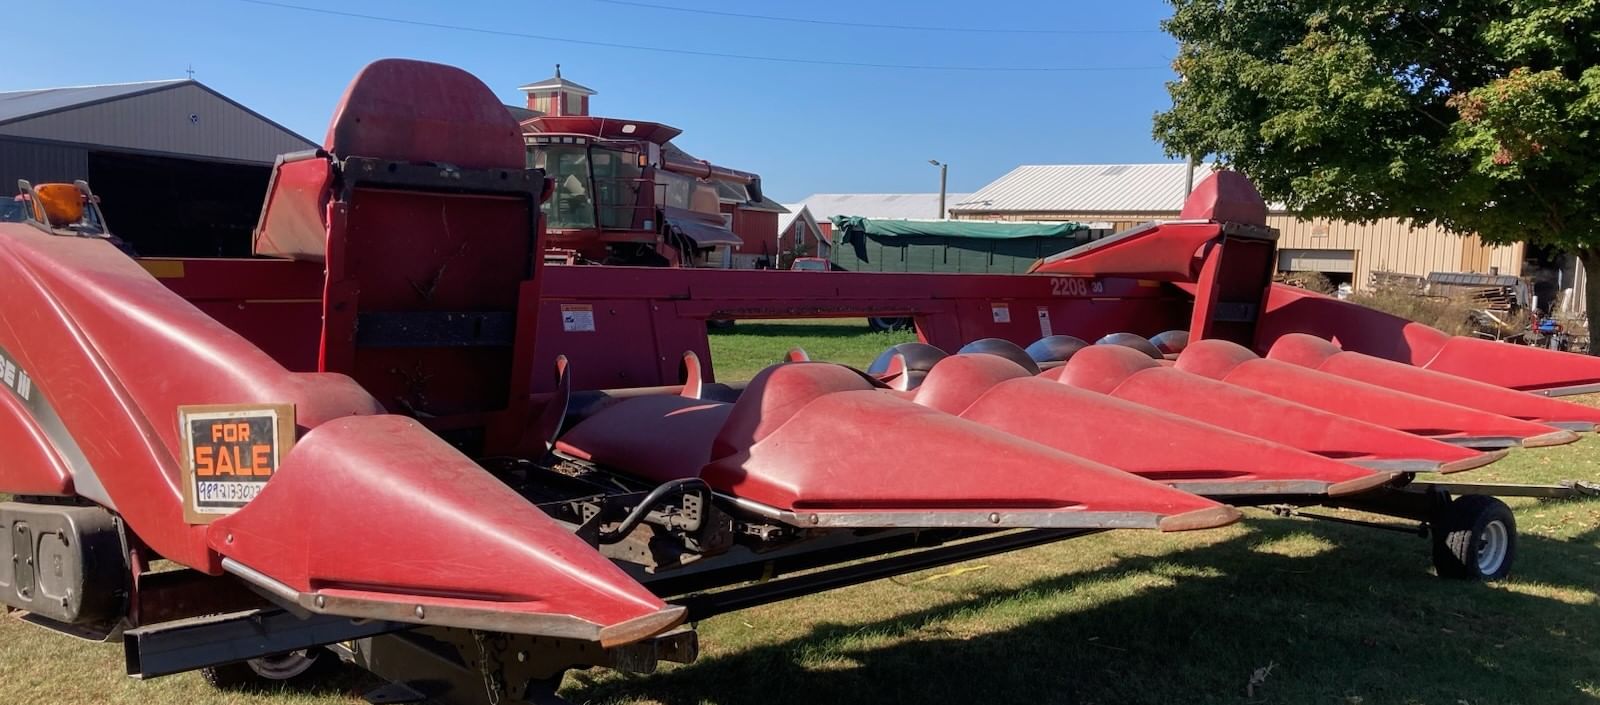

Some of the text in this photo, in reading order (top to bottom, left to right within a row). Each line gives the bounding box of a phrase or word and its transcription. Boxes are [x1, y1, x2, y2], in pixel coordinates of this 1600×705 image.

[1050, 278, 1103, 296] 2208 30
[212, 423, 250, 442] FOR
[196, 445, 271, 476] SALE
